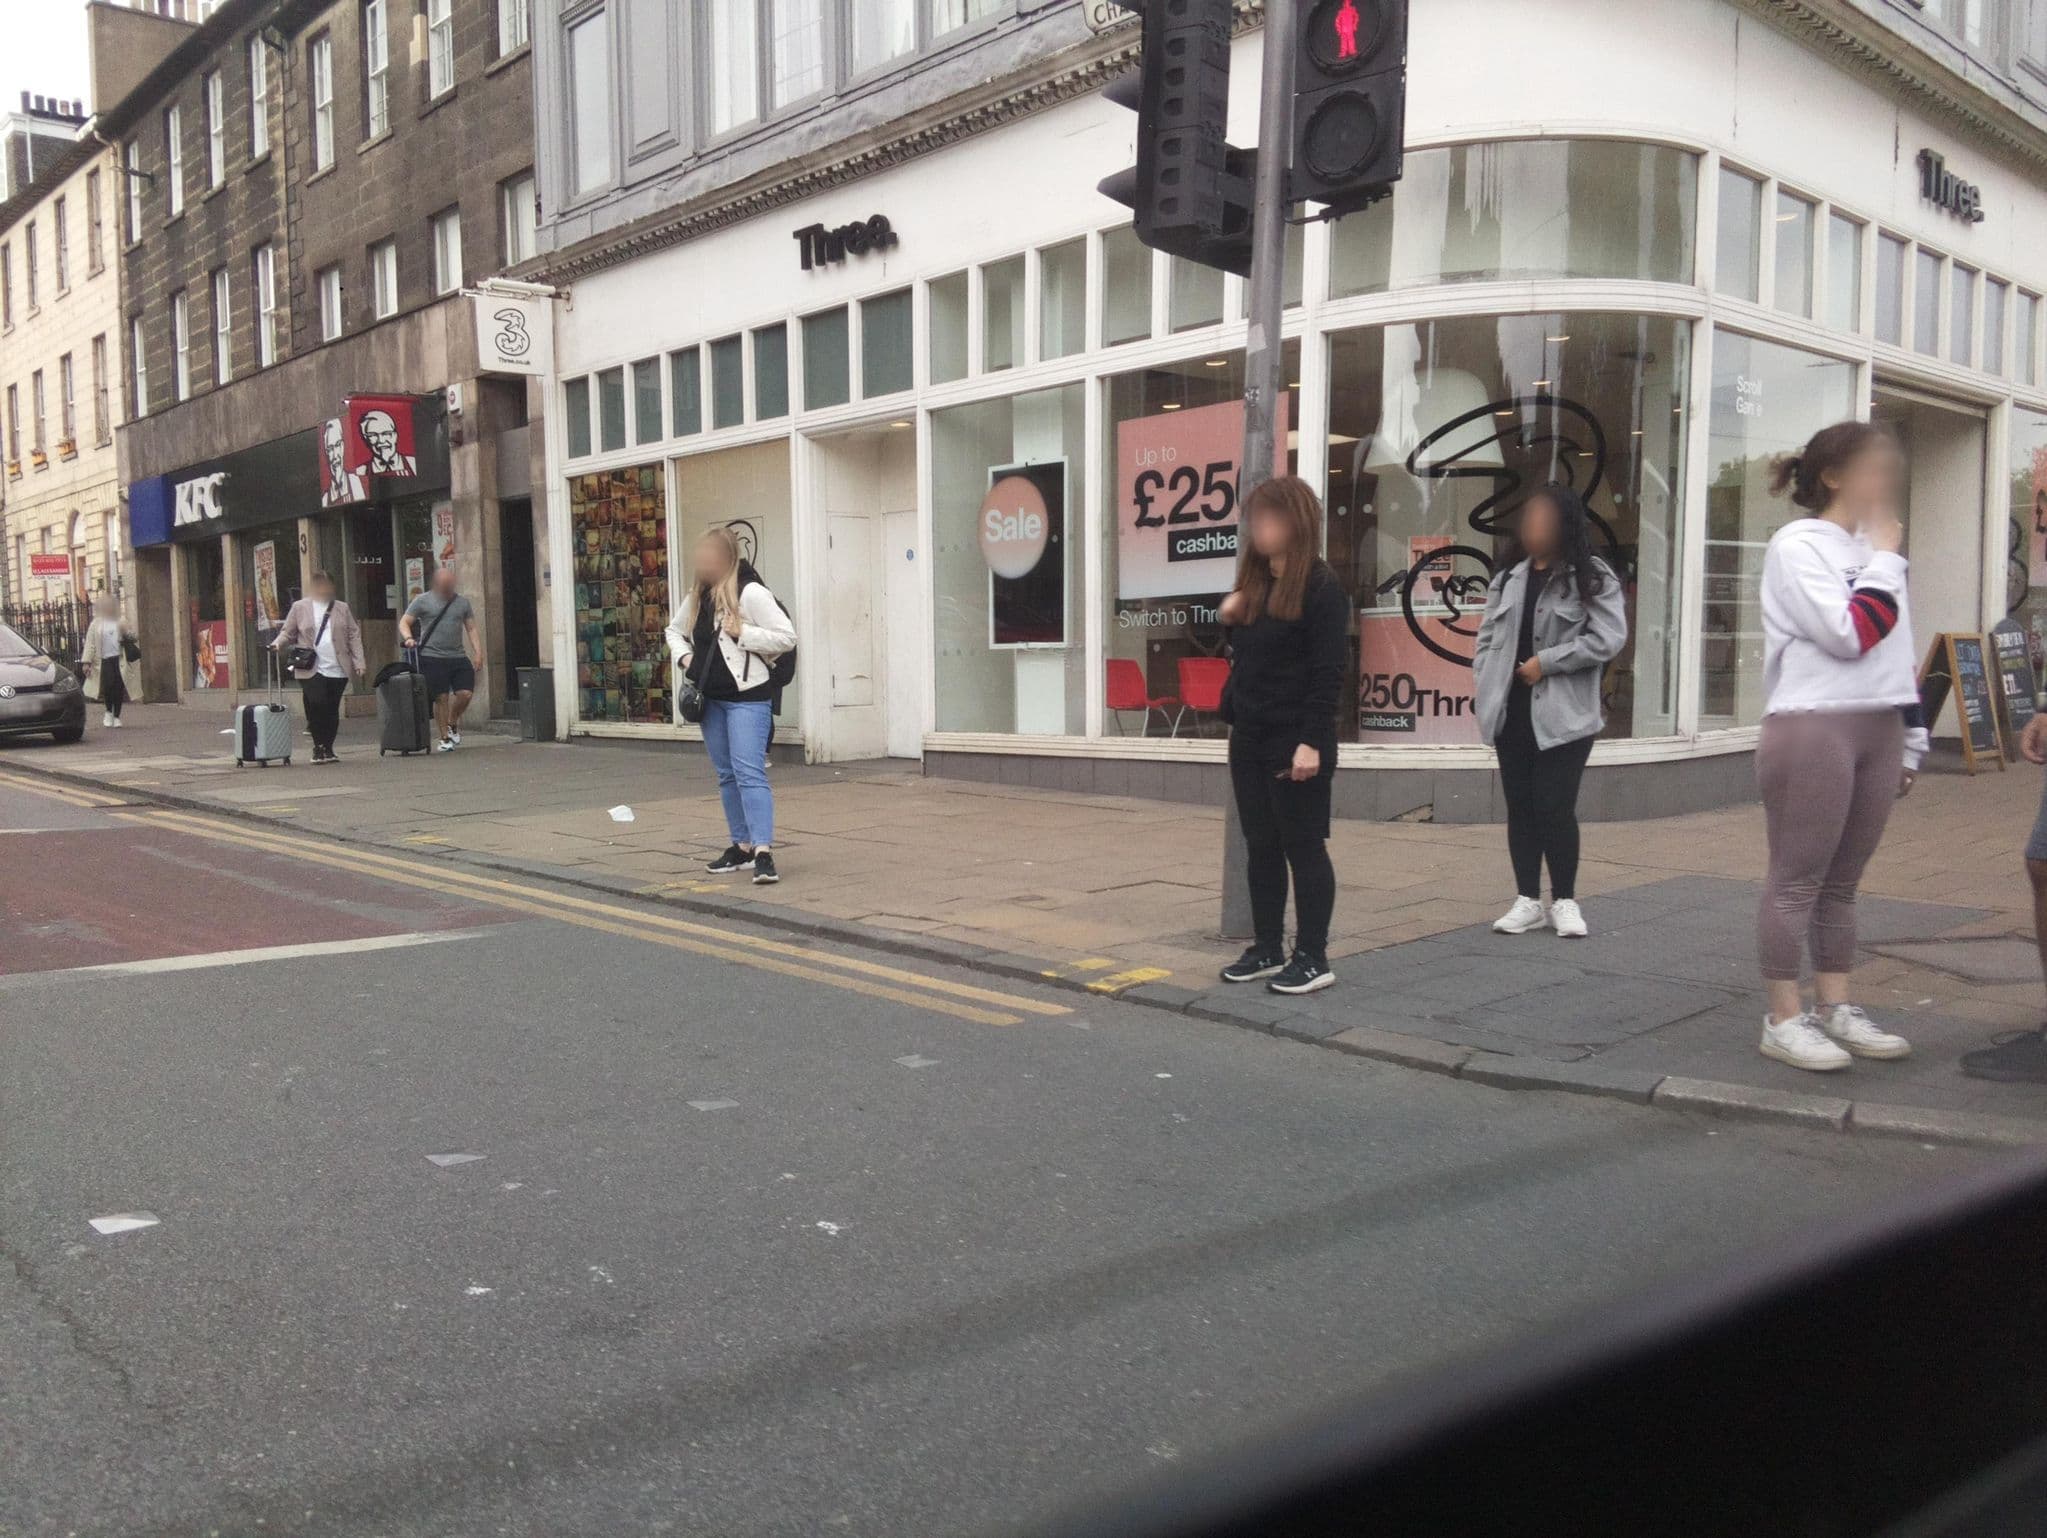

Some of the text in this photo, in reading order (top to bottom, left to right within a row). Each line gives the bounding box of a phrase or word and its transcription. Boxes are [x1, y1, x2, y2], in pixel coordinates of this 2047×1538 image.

[1135, 446, 1176, 467] Up to
[173, 472, 225, 527] KFC
[1133, 461, 1241, 528] £25
[985, 506, 1041, 543] Sale
[301, 533, 307, 554] 3
[1176, 532, 1238, 554] cashba
[1119, 605, 1219, 628] Switch to Thr
[1415, 690, 1476, 716] Thr
